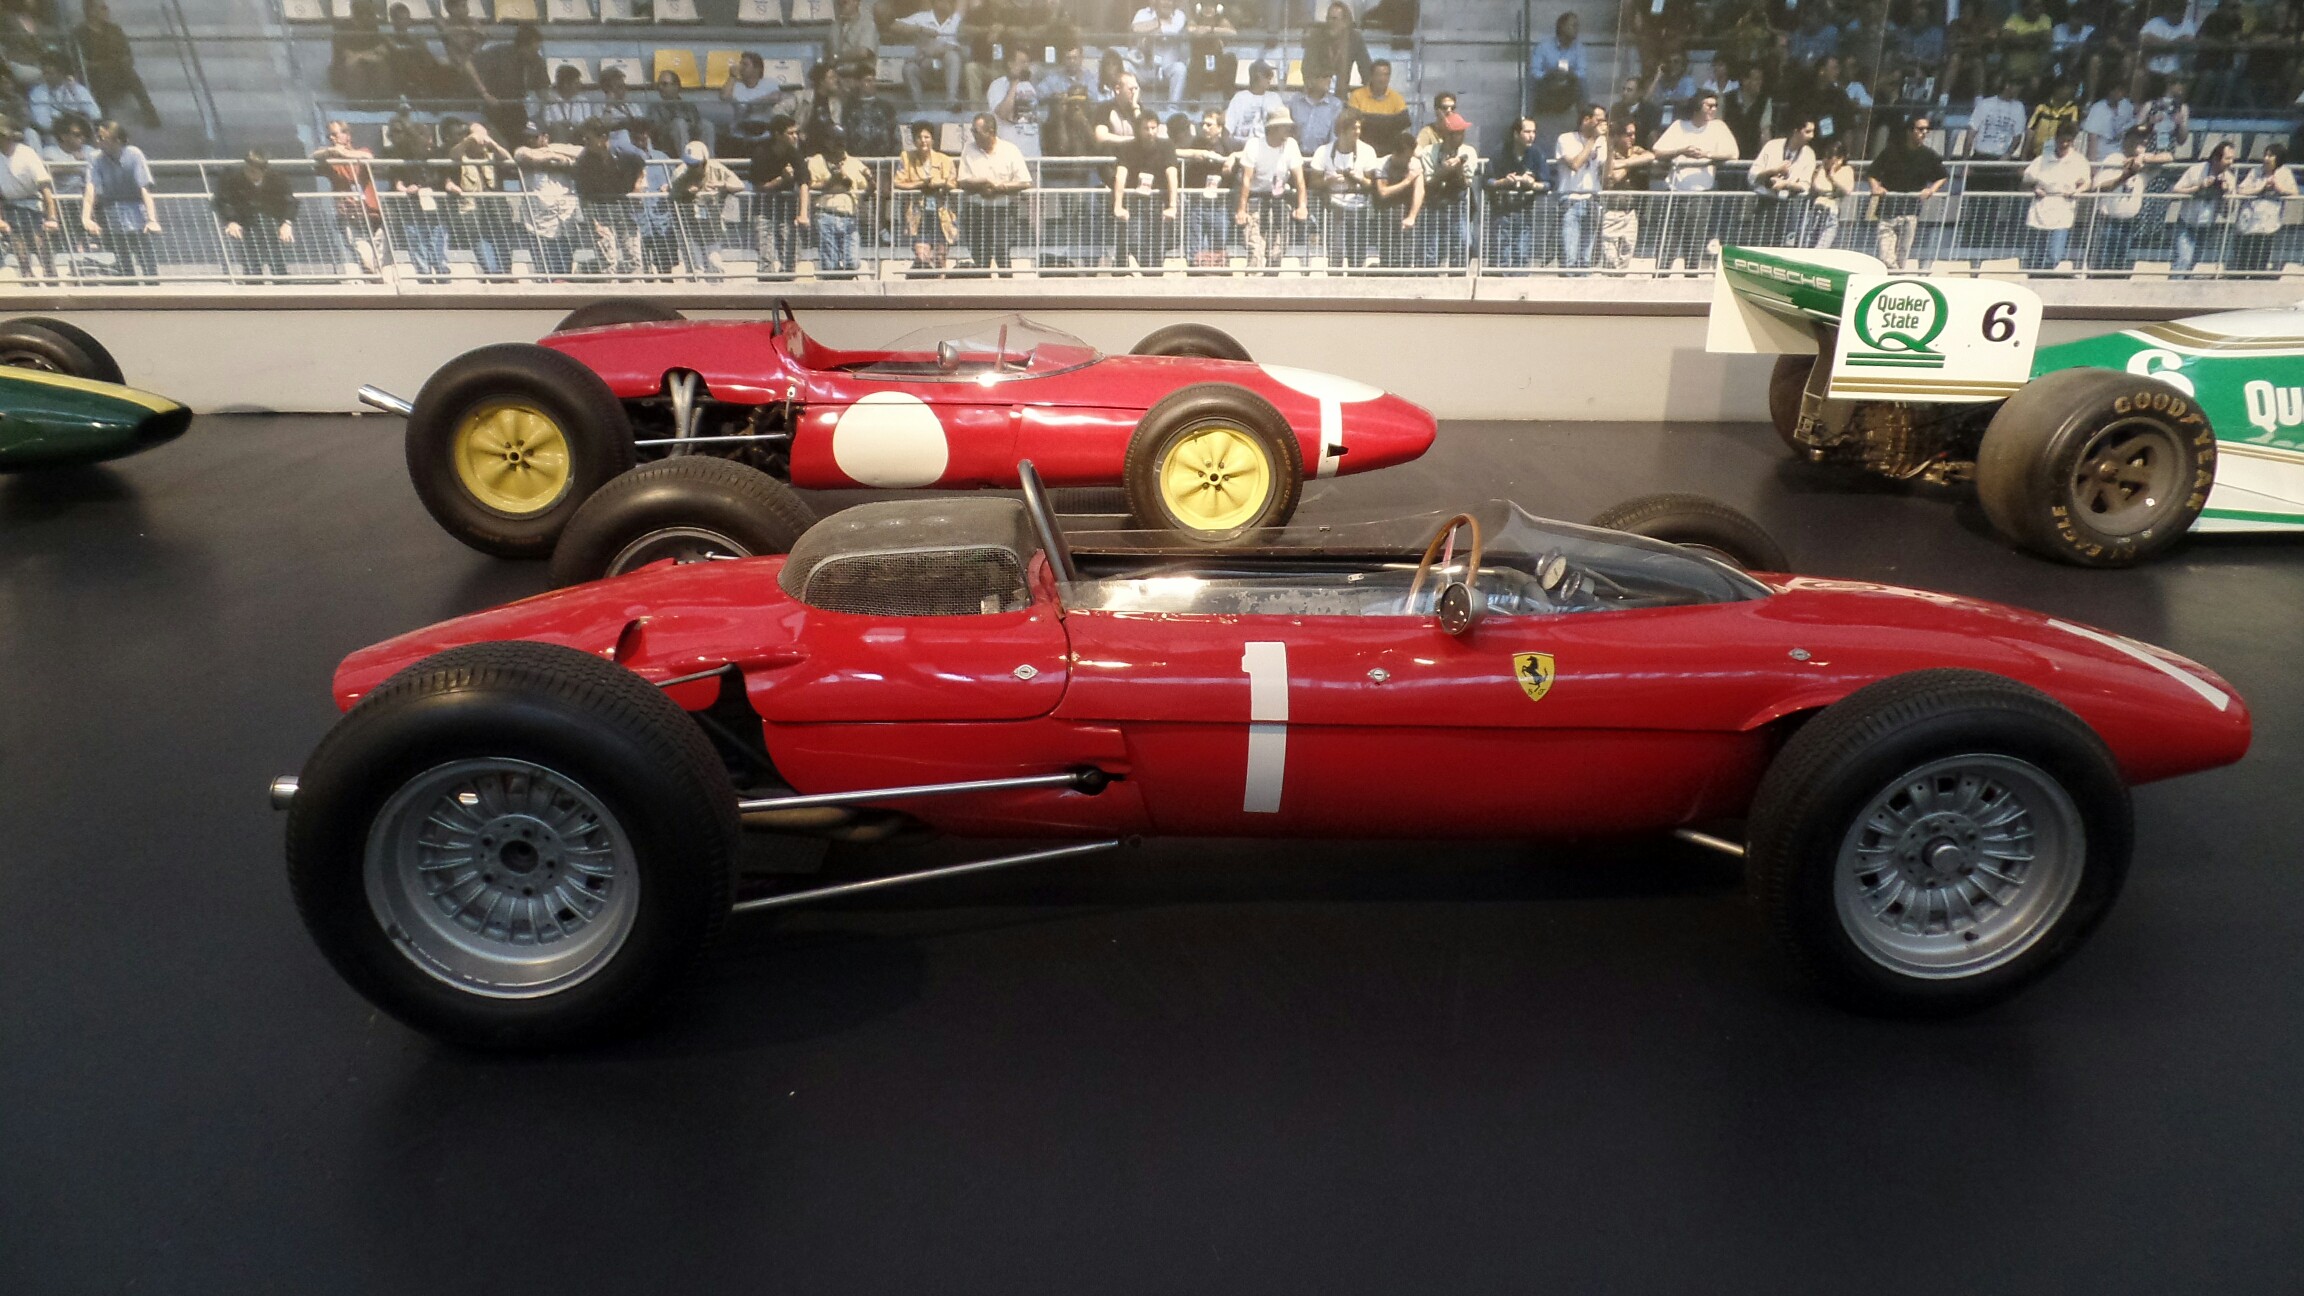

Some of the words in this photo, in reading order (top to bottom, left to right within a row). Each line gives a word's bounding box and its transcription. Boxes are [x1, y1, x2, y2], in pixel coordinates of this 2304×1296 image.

[1734, 258, 1832, 292] PORSCHE
[1877, 294, 1930, 313] Quaker
[1881, 312, 1919, 329] State
[1981, 301, 2018, 342] 6
[2244, 379, 2304, 433] Qu
[1242, 641, 1289, 814] 1
